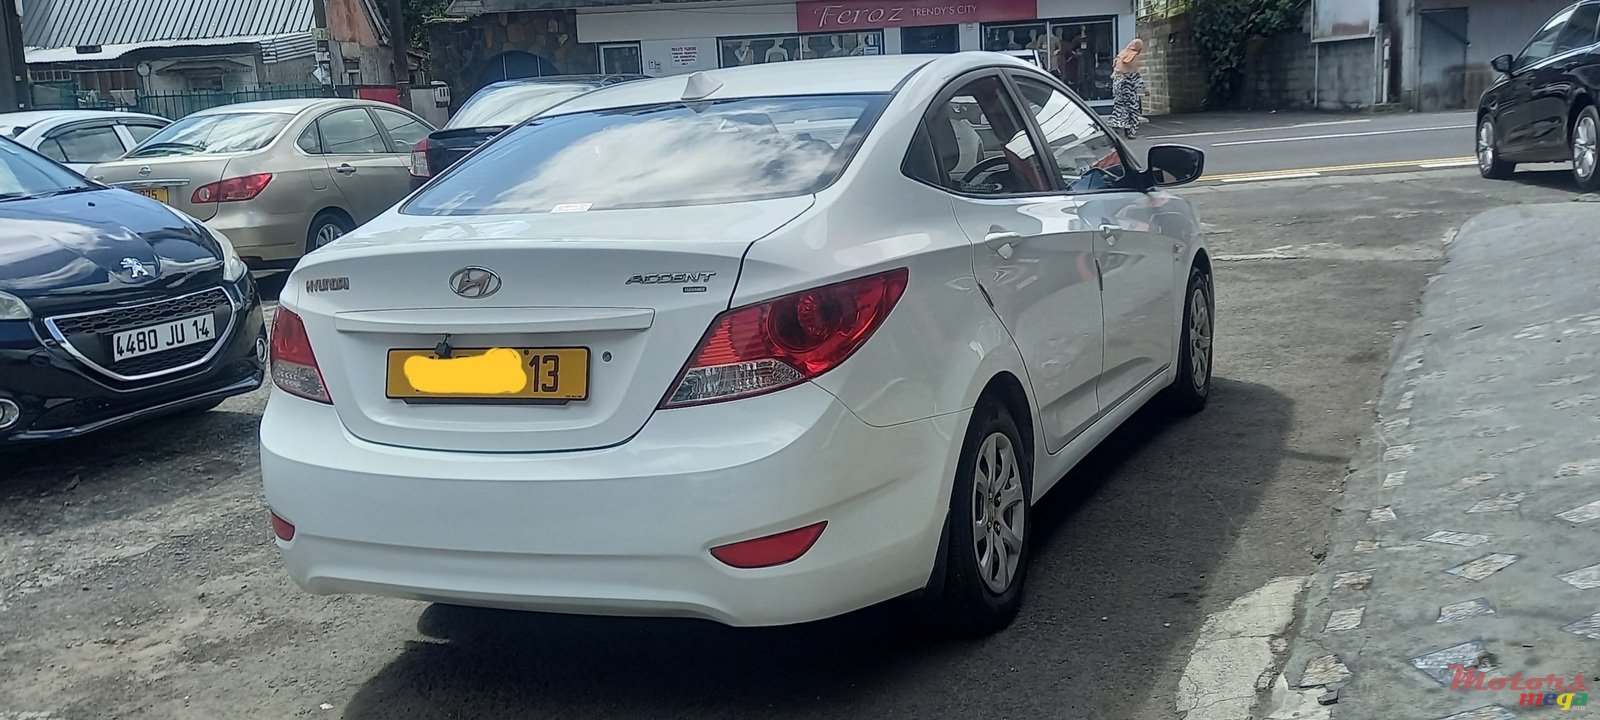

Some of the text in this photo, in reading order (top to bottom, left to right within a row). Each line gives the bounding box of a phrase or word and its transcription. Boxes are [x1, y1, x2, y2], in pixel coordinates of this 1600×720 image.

[911, 5, 978, 17] TRENDY'S CITY
[306, 277, 350, 293] HYUNDAI
[625, 271, 717, 285] ACCENT
[116, 317, 210, 357] 4480 JU 14
[529, 355, 560, 393] 13
